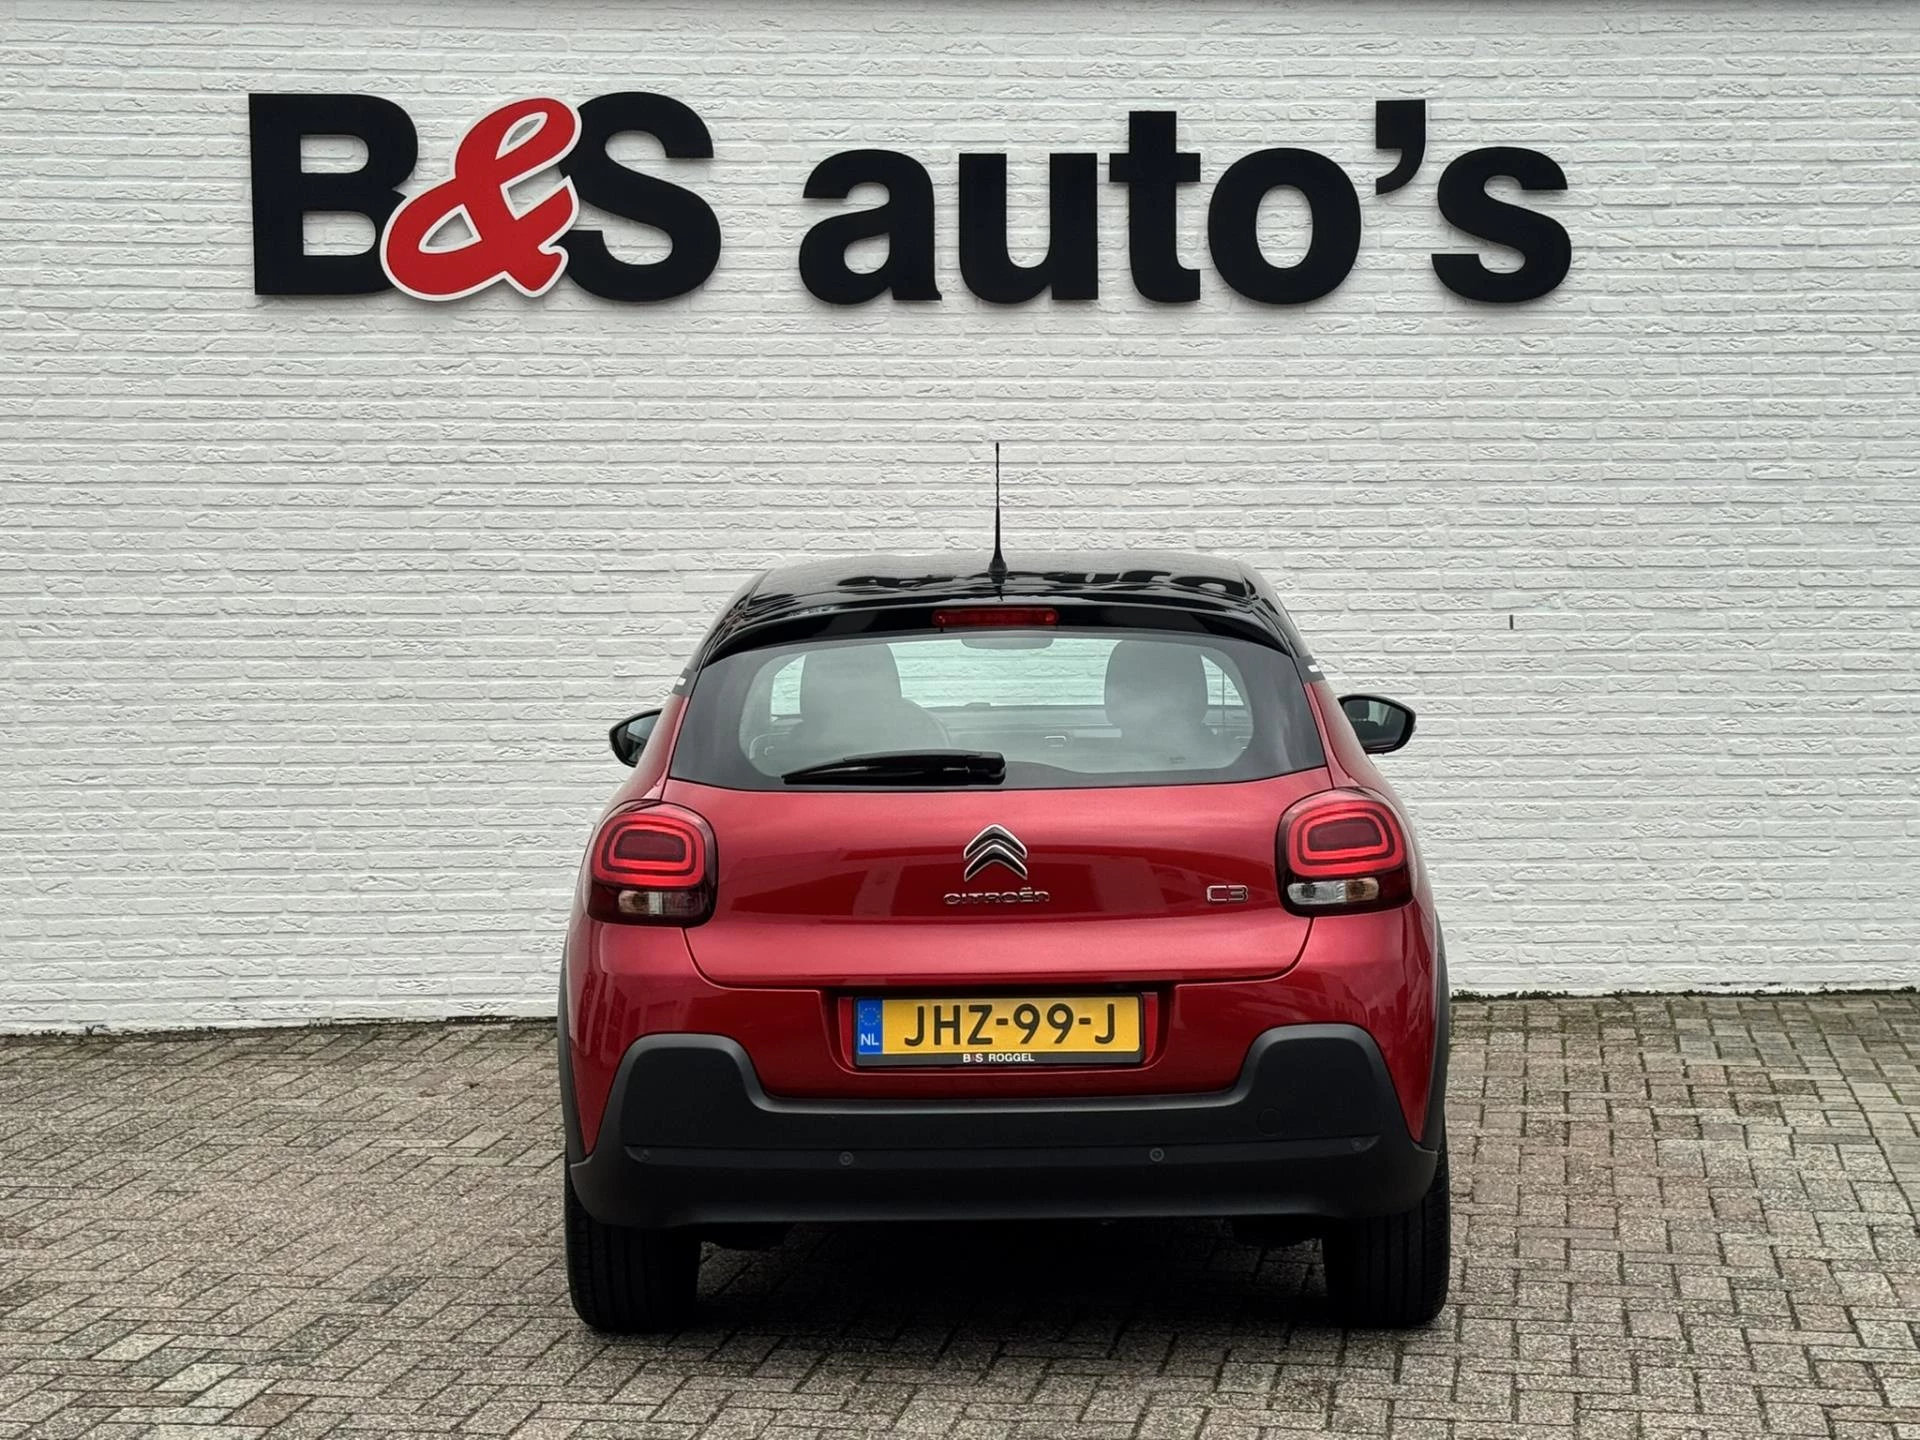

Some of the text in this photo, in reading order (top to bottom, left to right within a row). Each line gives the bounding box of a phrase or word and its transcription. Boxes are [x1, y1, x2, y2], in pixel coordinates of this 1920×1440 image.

[248, 91, 1573, 305] B&S auto's
[1206, 884, 1249, 904] C3
[904, 1003, 1116, 1047] JHZ-99-J
[860, 1033, 880, 1047] NL
[988, 1053, 1035, 1062] ROGGEL
